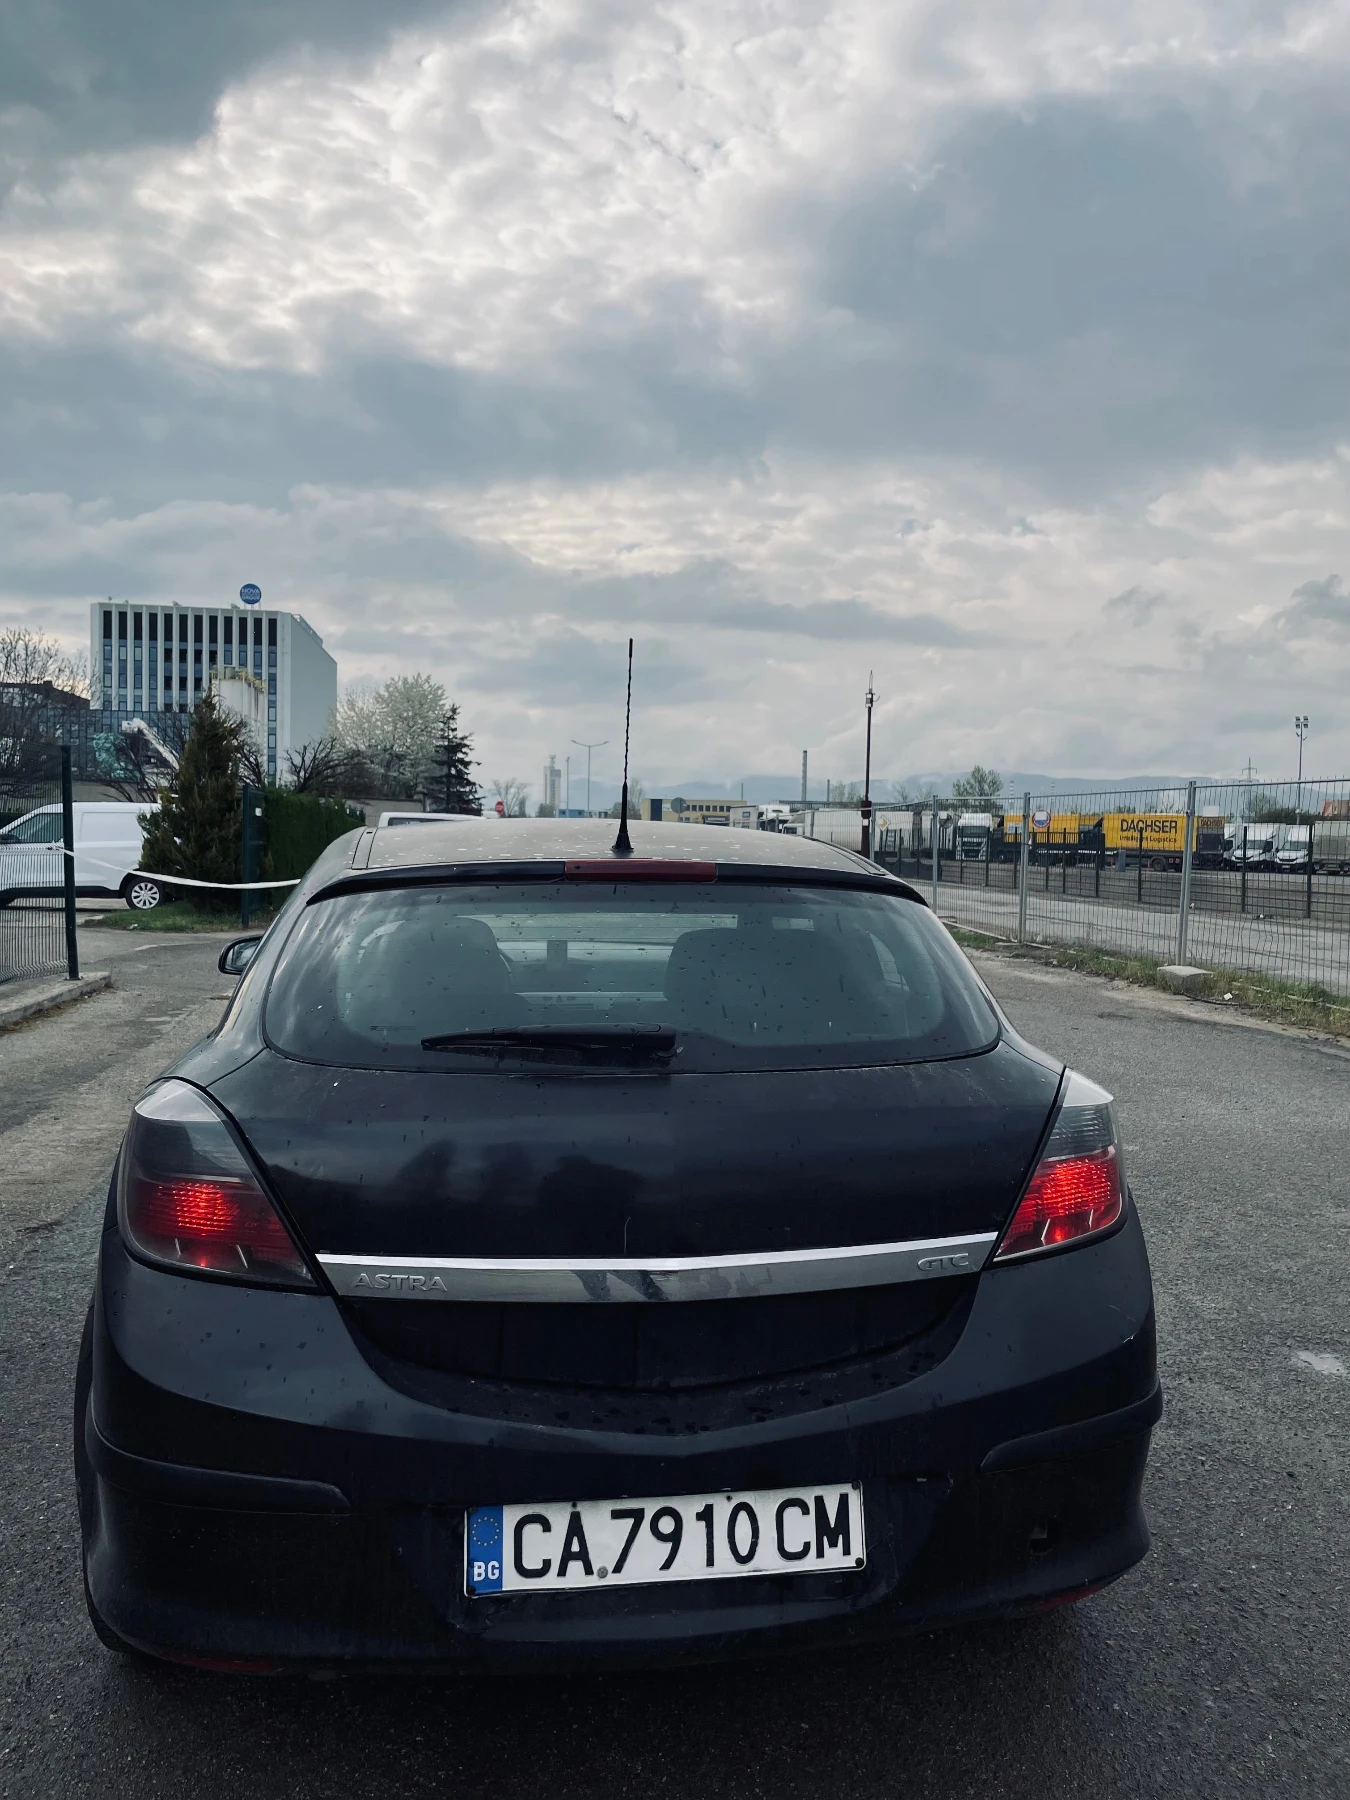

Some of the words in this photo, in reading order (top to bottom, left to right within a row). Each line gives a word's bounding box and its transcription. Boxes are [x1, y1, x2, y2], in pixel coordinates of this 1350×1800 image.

[1120, 819, 1177, 833] DACHSER
[917, 1252, 969, 1272] GTC
[355, 1273, 448, 1292] ASTRA
[472, 1561, 500, 1582] BG
